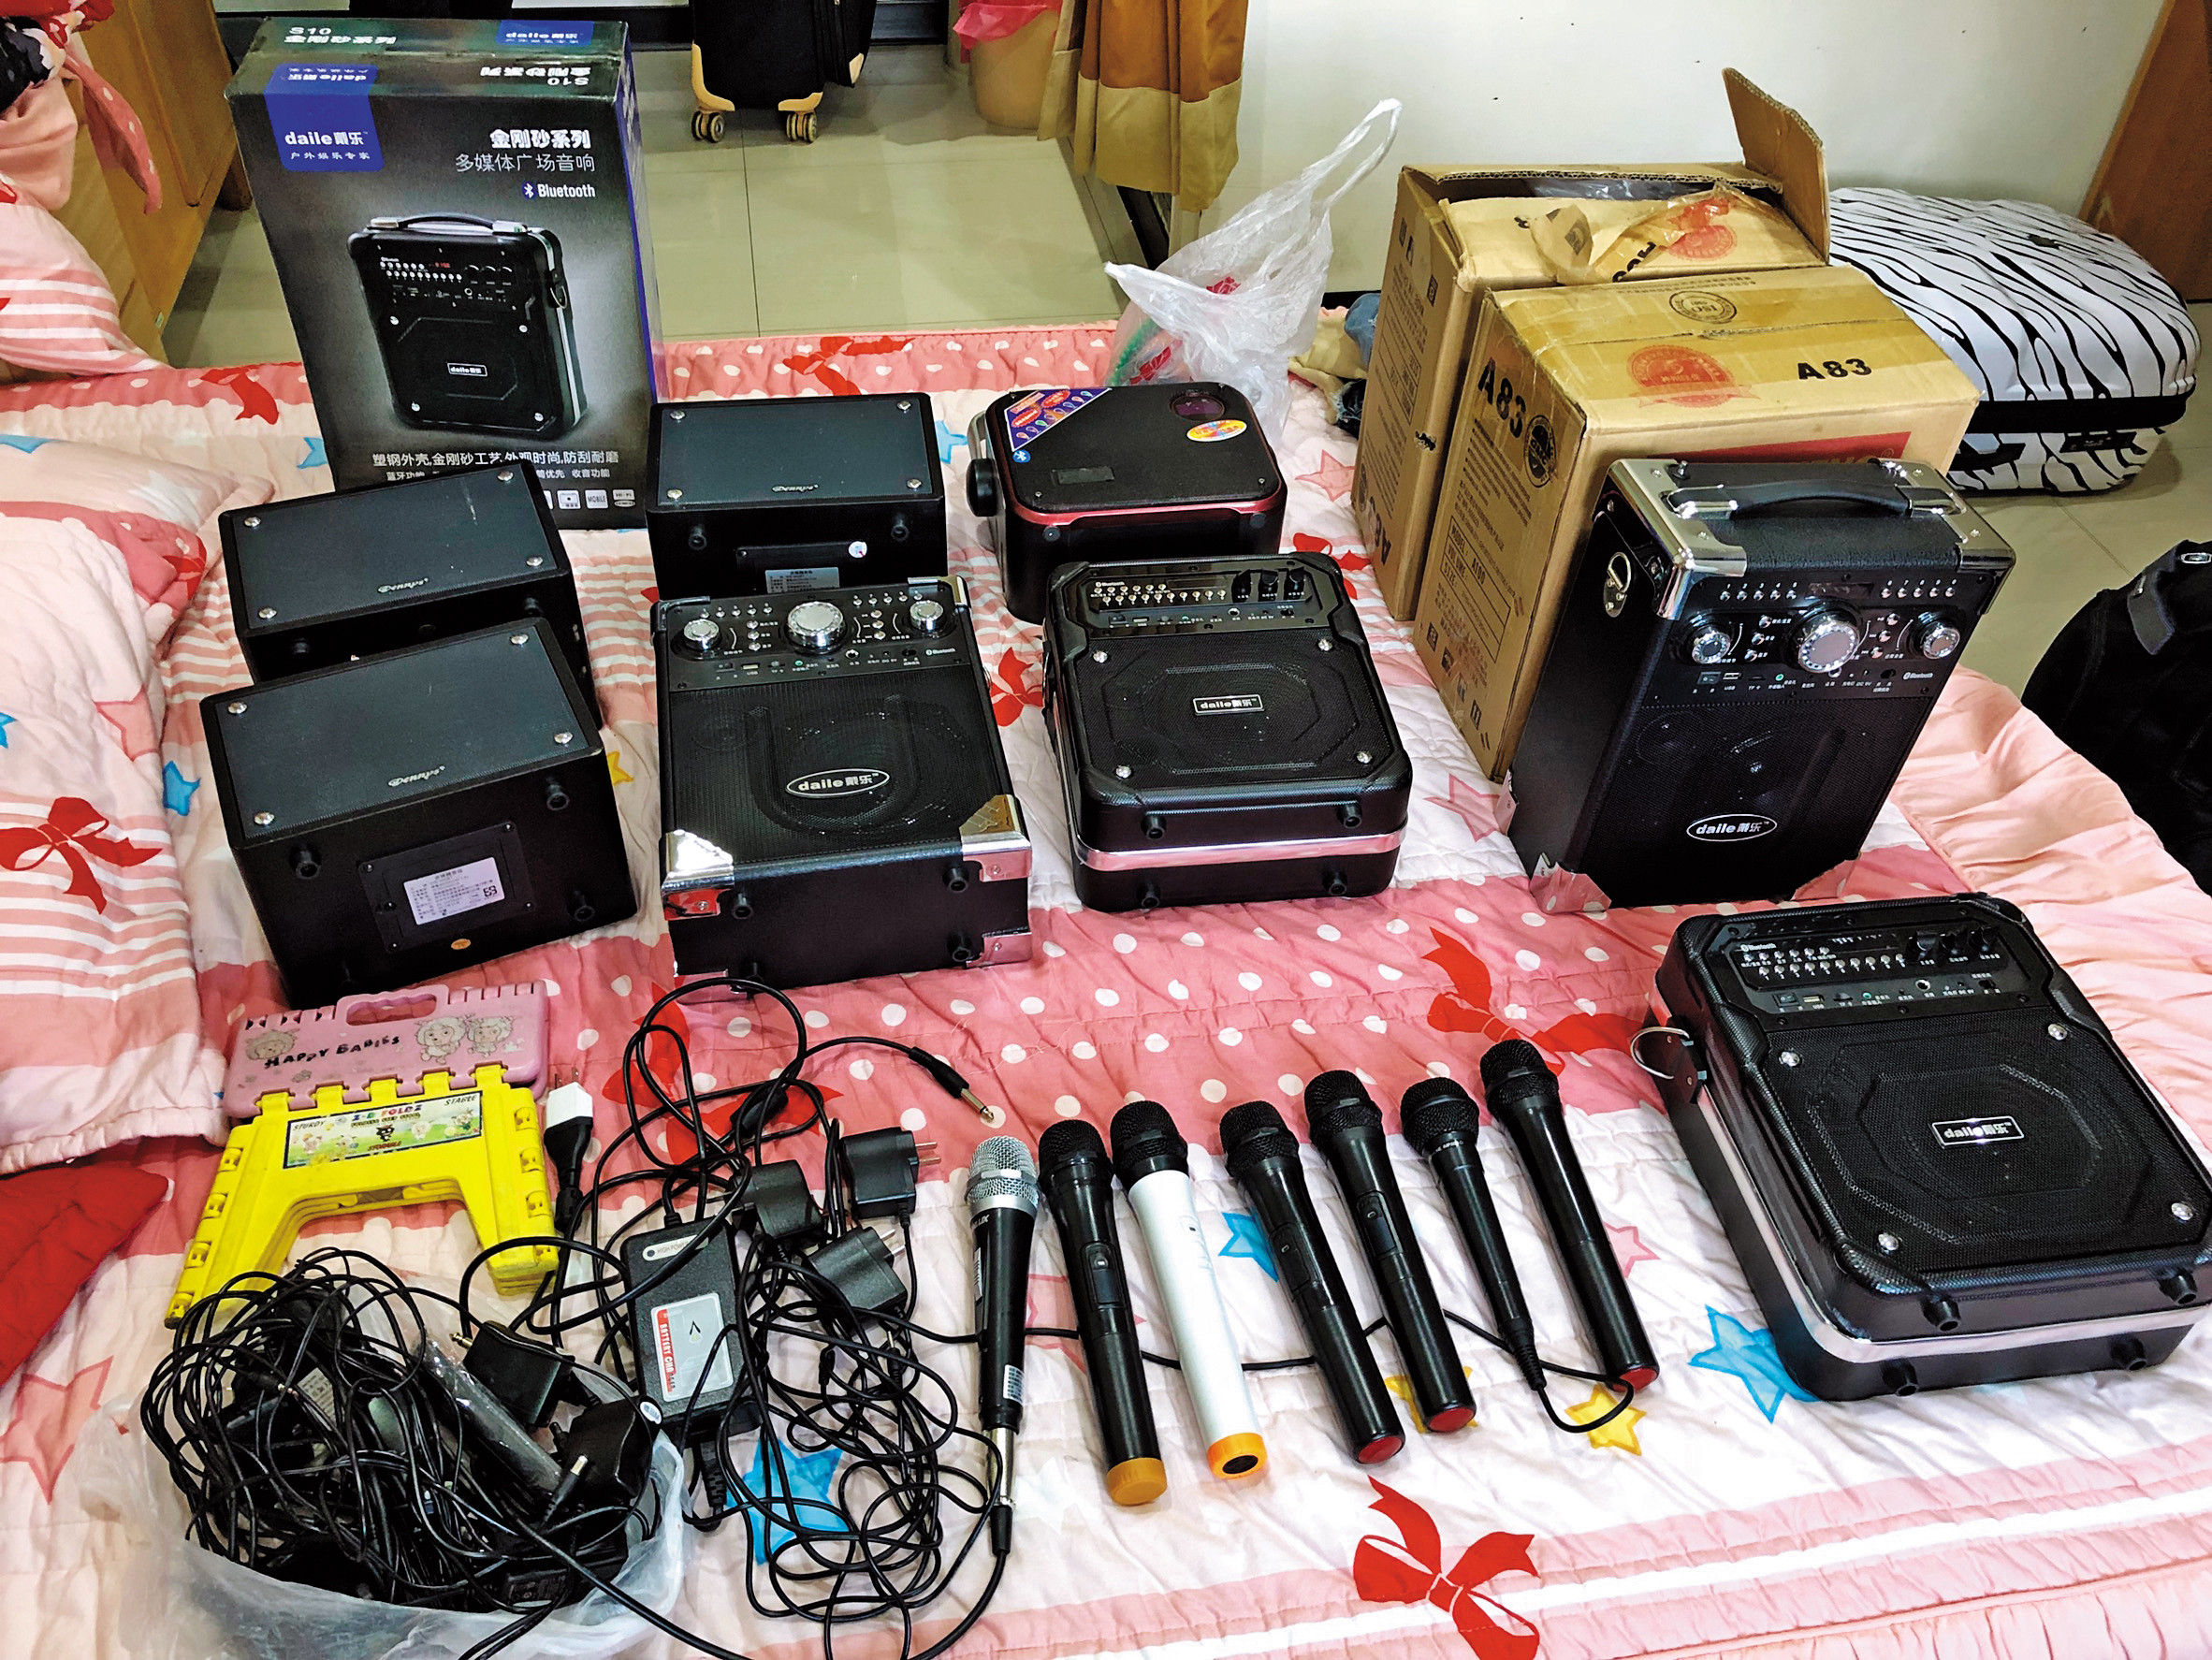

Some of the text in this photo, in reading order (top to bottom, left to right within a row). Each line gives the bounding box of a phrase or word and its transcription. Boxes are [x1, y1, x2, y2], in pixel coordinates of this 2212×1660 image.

[284, 131, 332, 145] daile
[489, 129, 591, 149] 金刚砂系列
[455, 153, 595, 172] 多媒体广场音响
[537, 183, 596, 197] Bluetooth
[1797, 358, 1872, 380] A83
[1477, 357, 1525, 438] A83
[798, 779, 844, 792] daile
[1695, 823, 1737, 834] daile
[264, 1035, 400, 1070] HAPPY BABIES
